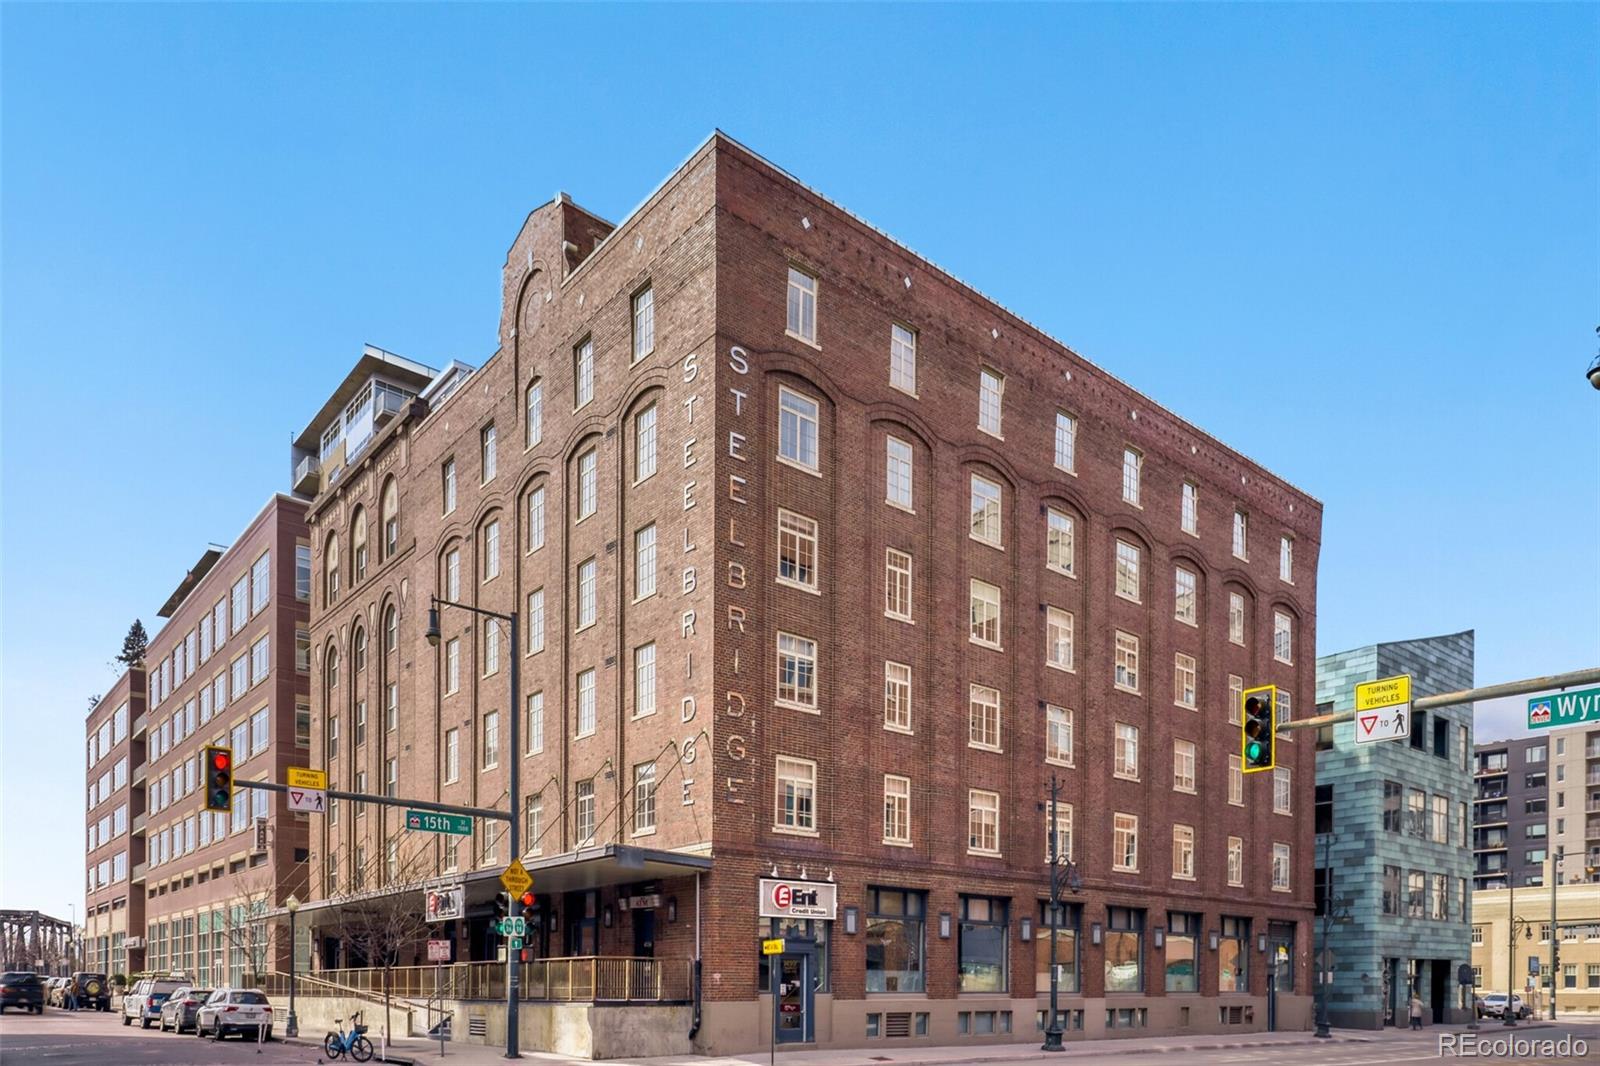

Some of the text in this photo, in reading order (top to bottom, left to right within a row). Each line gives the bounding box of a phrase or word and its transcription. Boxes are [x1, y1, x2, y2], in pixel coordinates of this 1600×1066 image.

[681, 353, 699, 807] STEELBRIDGE
[726, 345, 750, 804] STEELBRIDGE
[1367, 682, 1399, 694] TURNING
[1365, 693, 1400, 706] VEHICLES
[1380, 720, 1389, 728] TO
[296, 771, 319, 779] TURNING
[294, 779, 320, 787] VEHICLES
[423, 815, 450, 830] 15th
[792, 889, 818, 906] Ent
